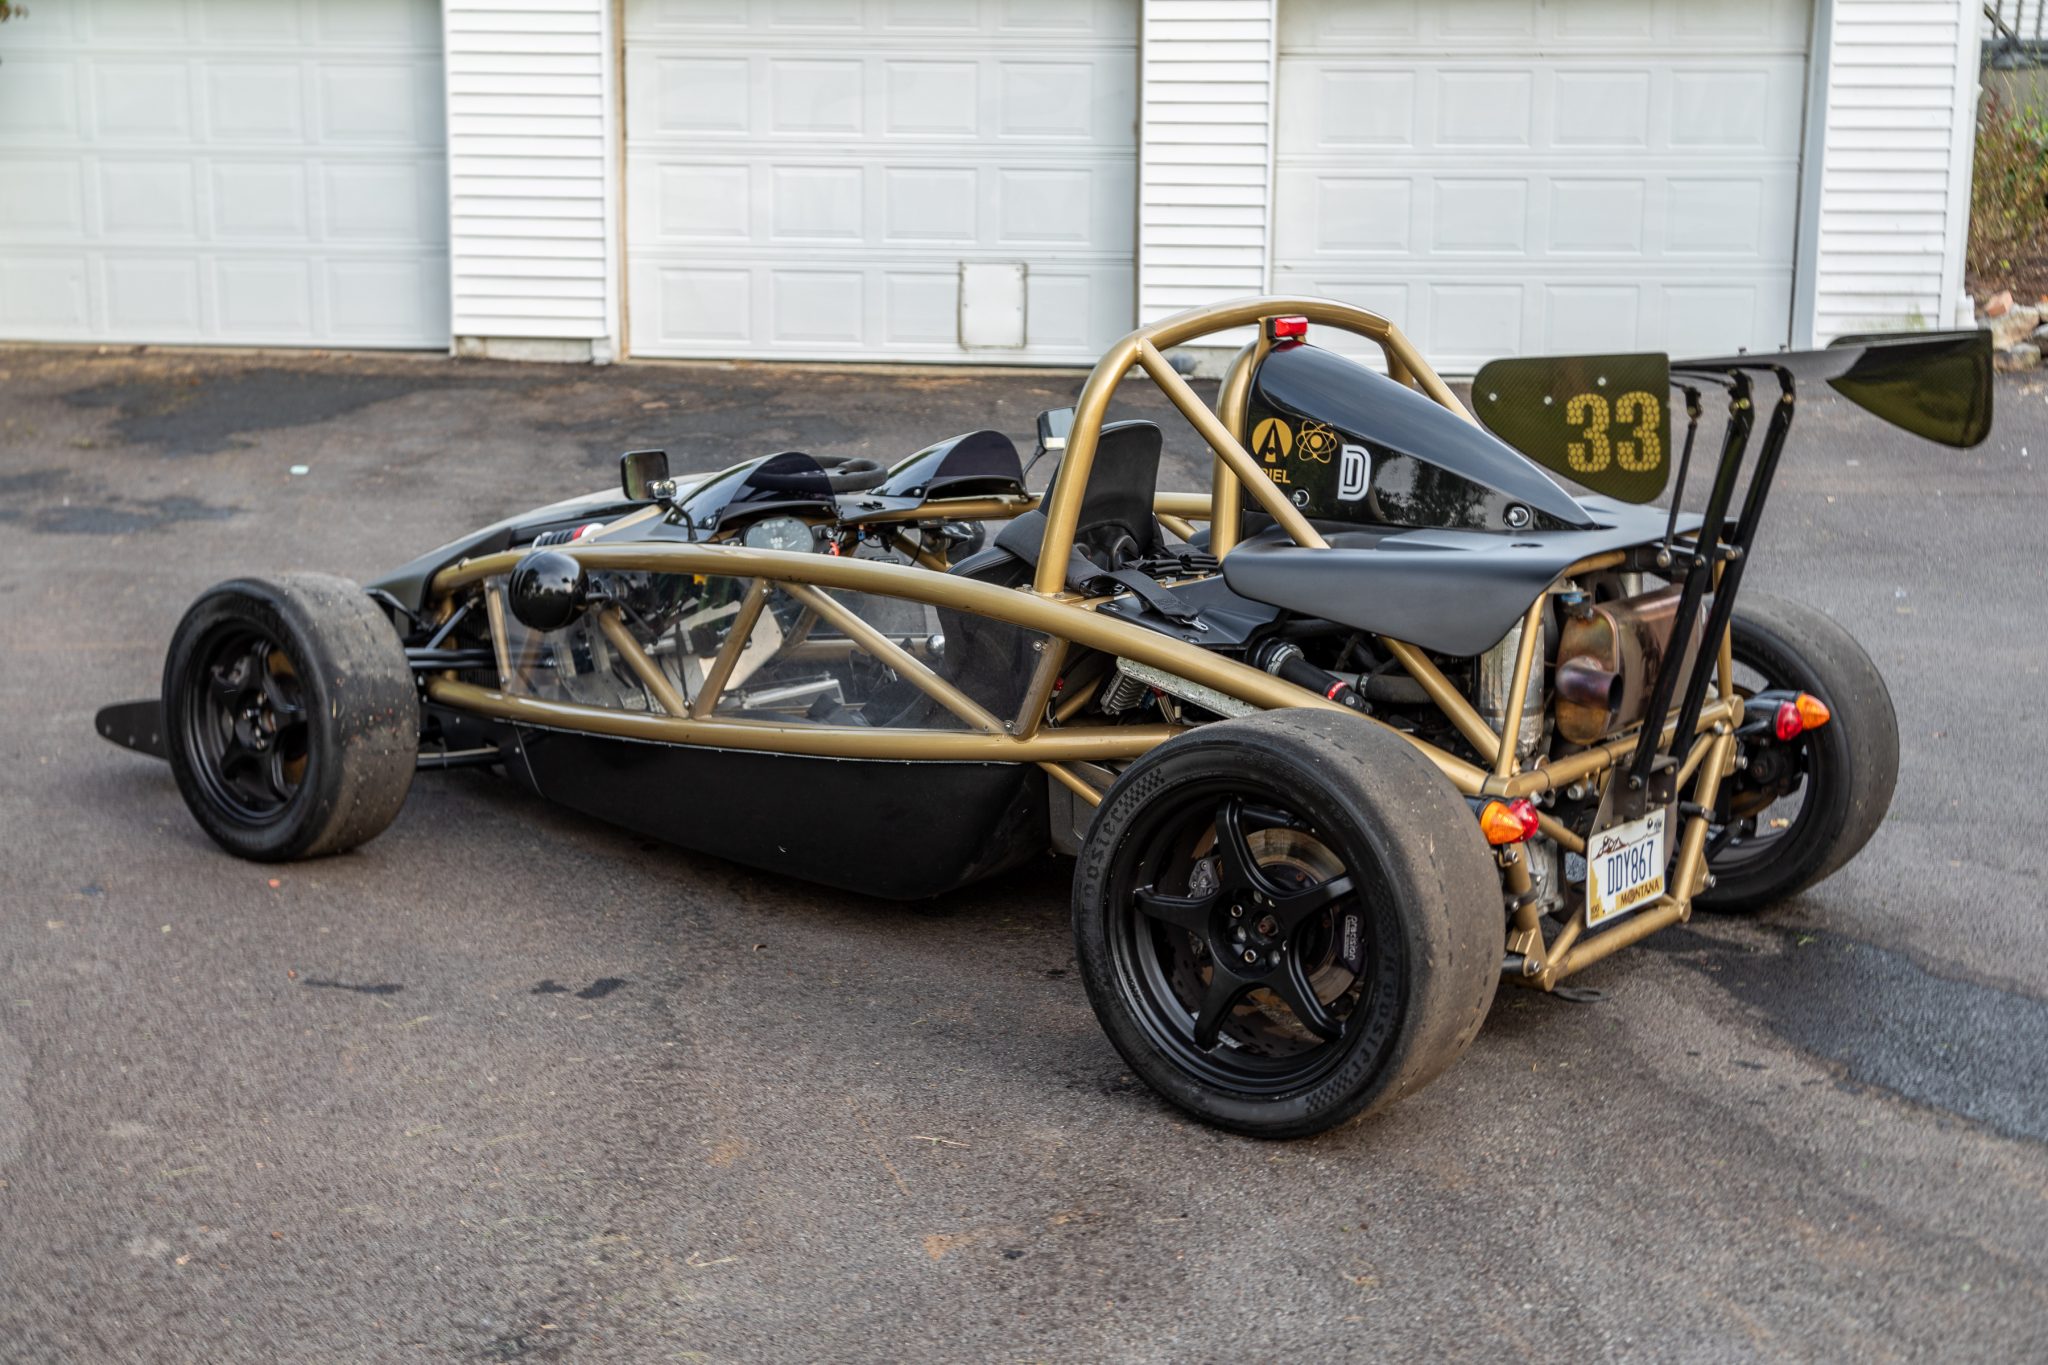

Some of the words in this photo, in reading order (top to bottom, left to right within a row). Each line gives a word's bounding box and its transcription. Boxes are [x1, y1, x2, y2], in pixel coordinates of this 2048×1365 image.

[1567, 391, 1661, 472] 33
[1261, 467, 1291, 484] IEL
[1338, 444, 1371, 501] D
[1607, 841, 1654, 896] DDY867
[1620, 879, 1660, 908] MONTANA
